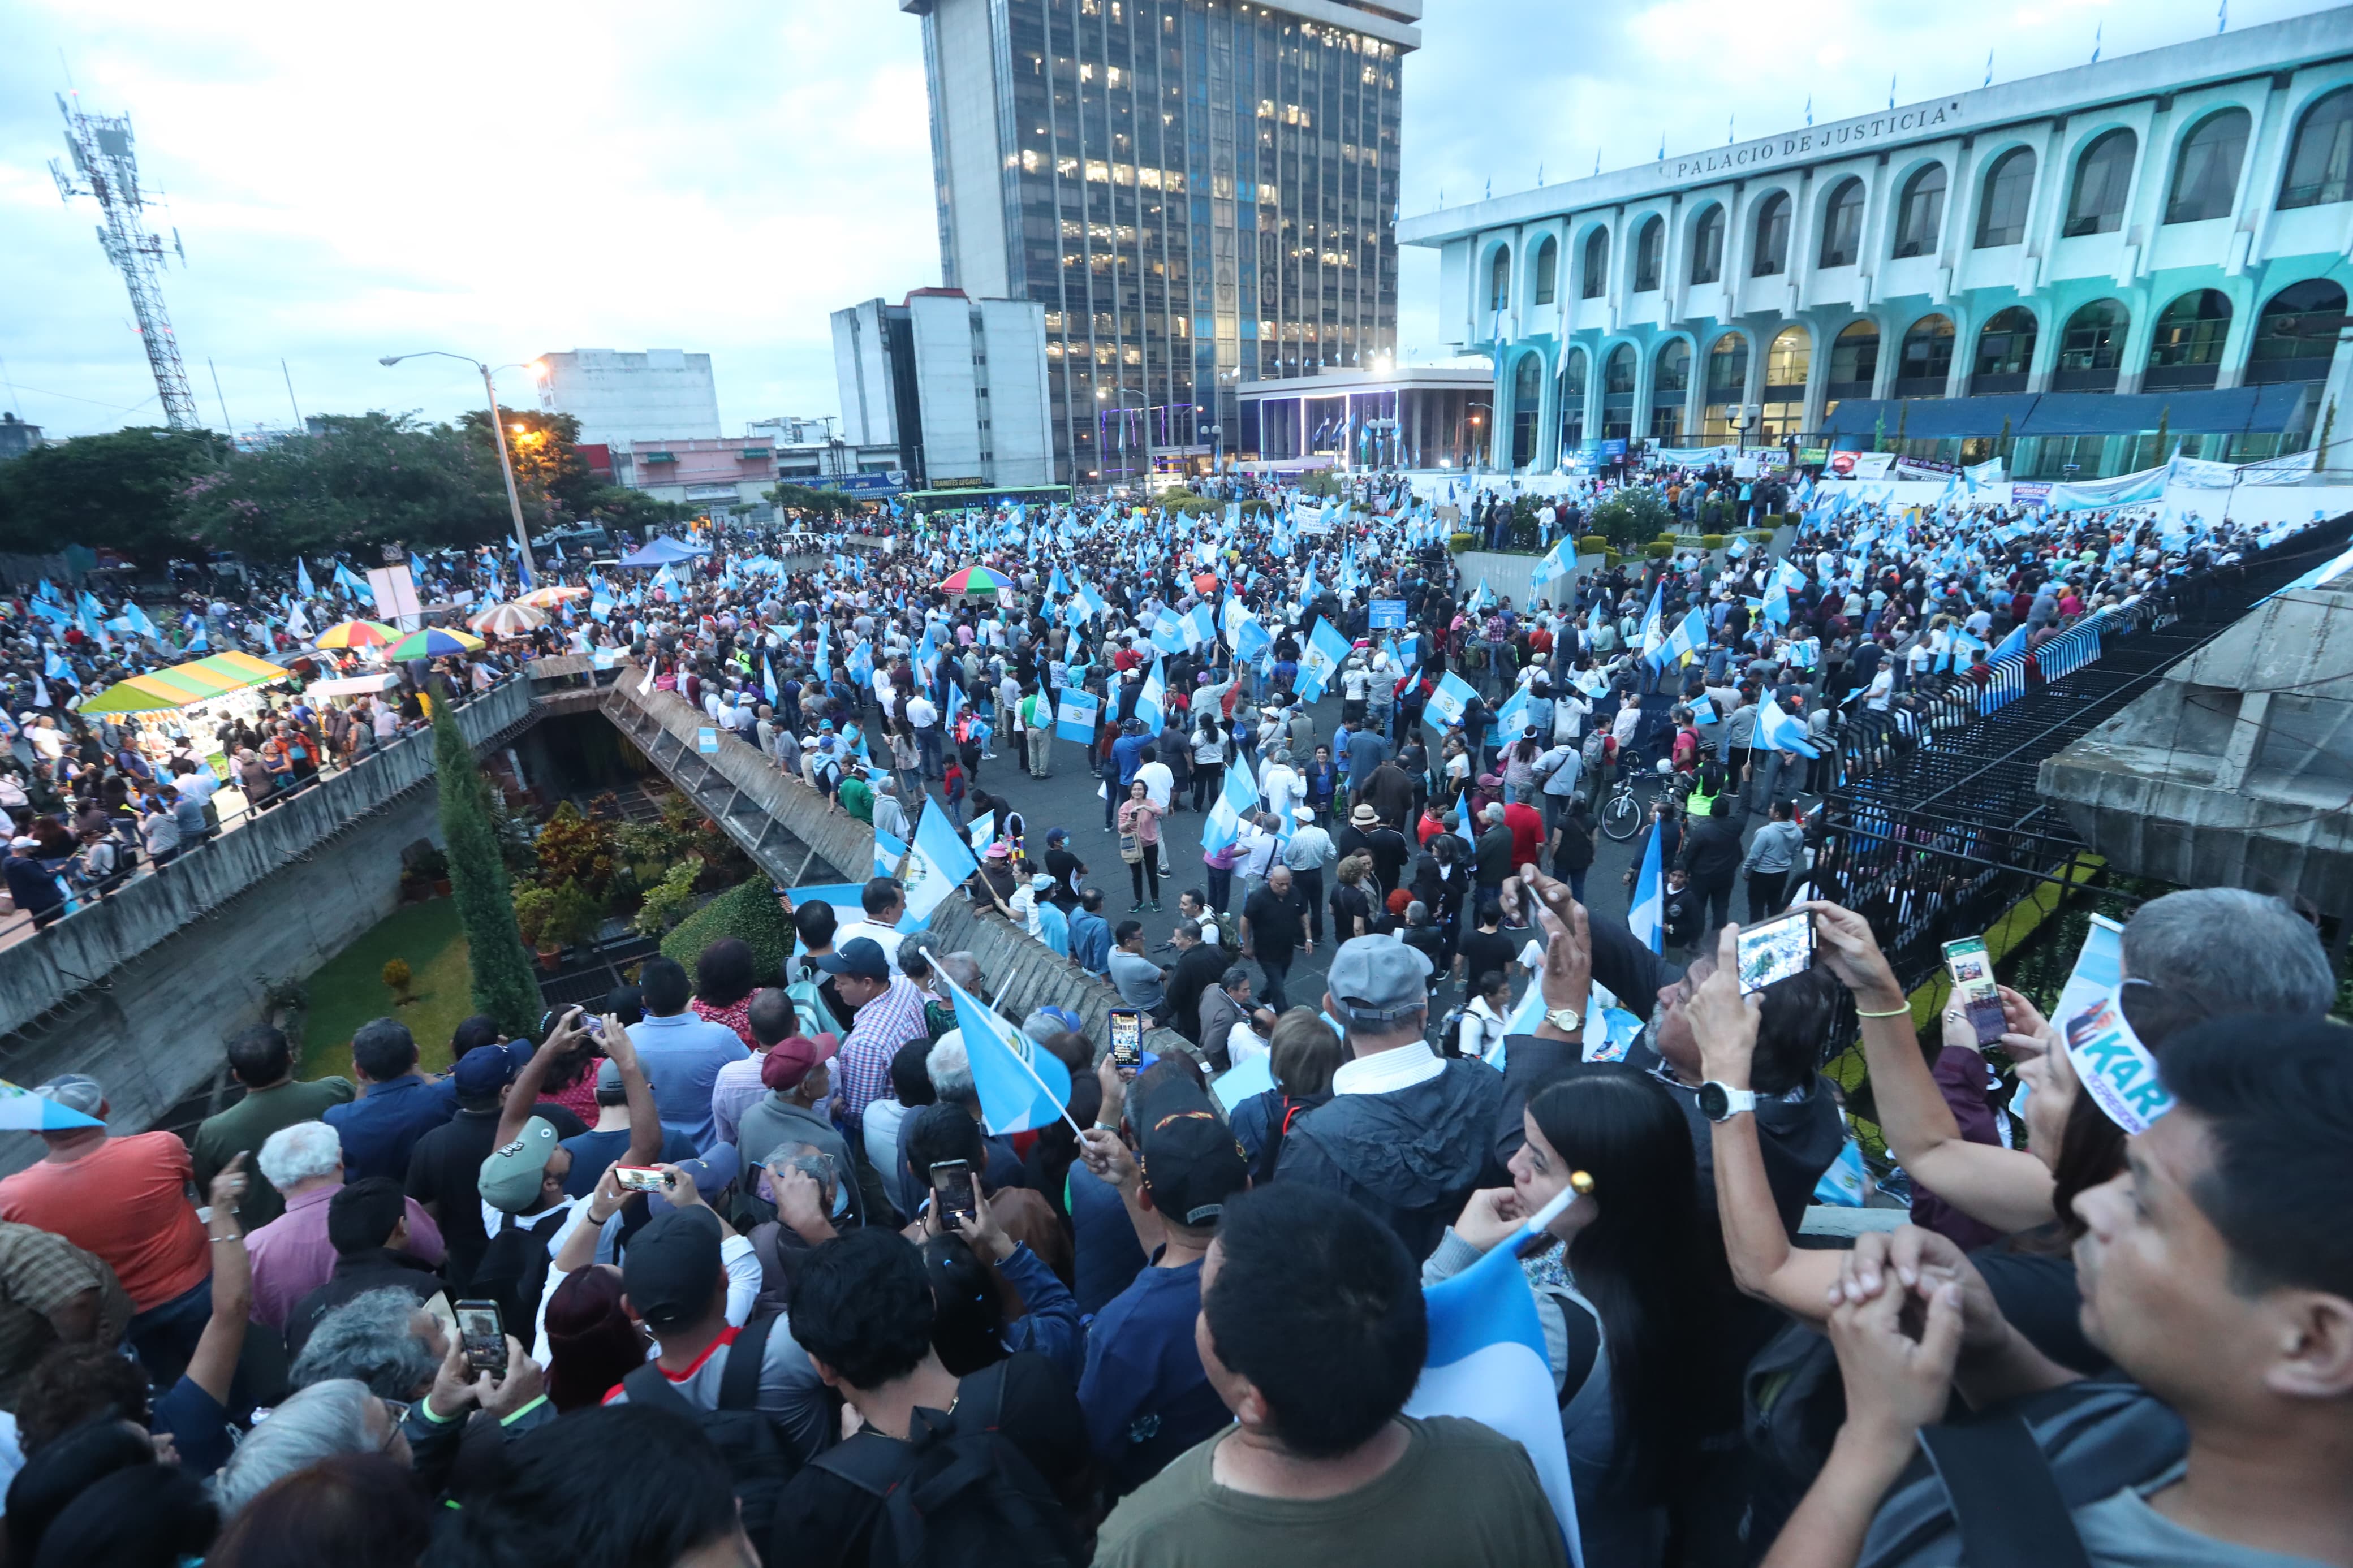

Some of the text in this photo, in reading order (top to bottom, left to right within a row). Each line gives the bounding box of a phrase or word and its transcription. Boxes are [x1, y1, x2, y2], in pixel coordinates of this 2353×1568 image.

[1677, 106, 1947, 178] PALACIO DE JUSTICIA
[2083, 1031, 2170, 1126] KAR
